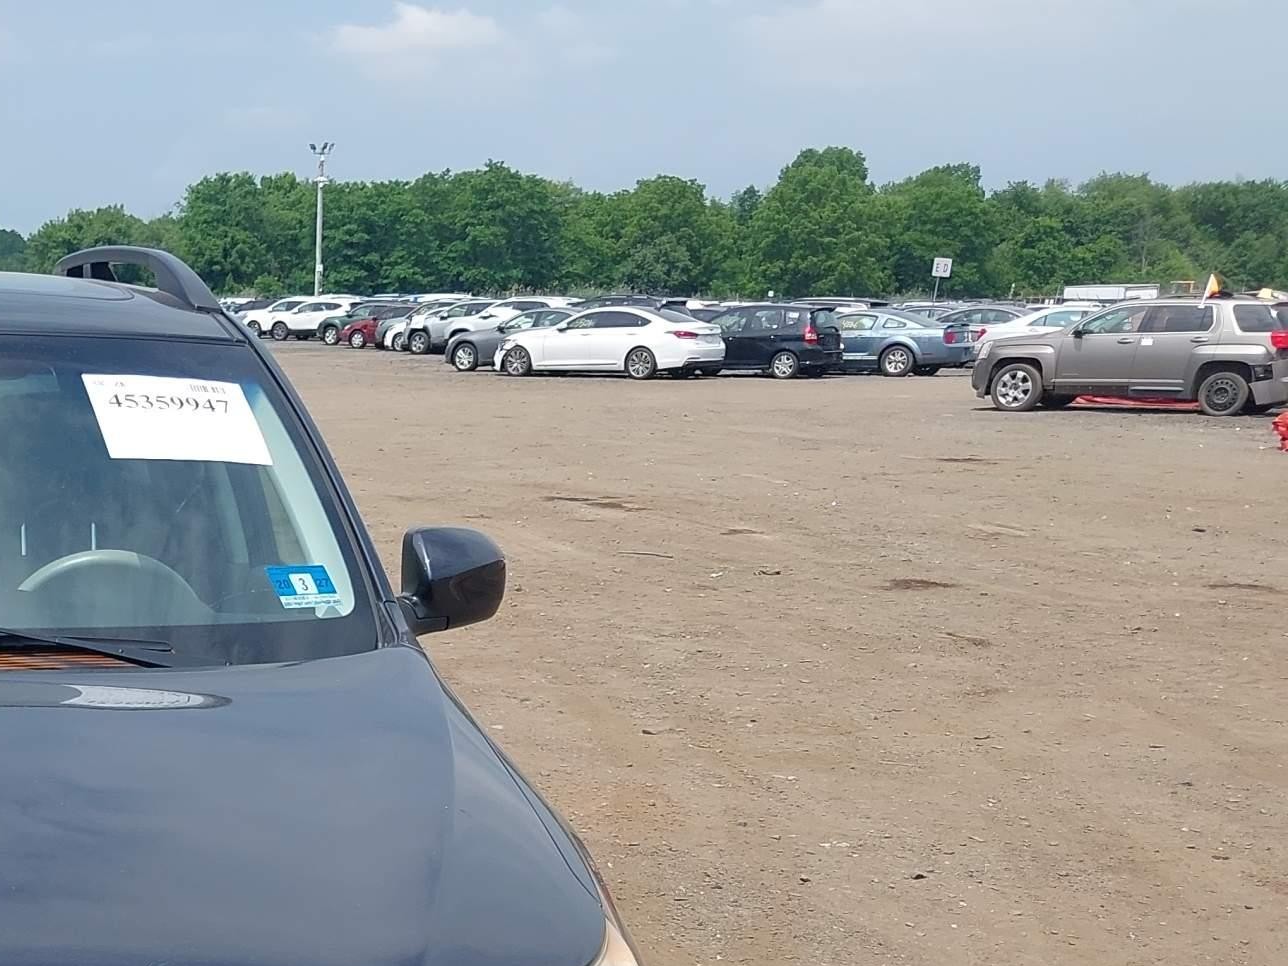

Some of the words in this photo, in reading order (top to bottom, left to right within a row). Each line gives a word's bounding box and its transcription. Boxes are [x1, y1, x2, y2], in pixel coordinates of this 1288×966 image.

[108, 393, 229, 414] 45359947
[275, 580, 290, 590] 20
[298, 577, 309, 591] 3
